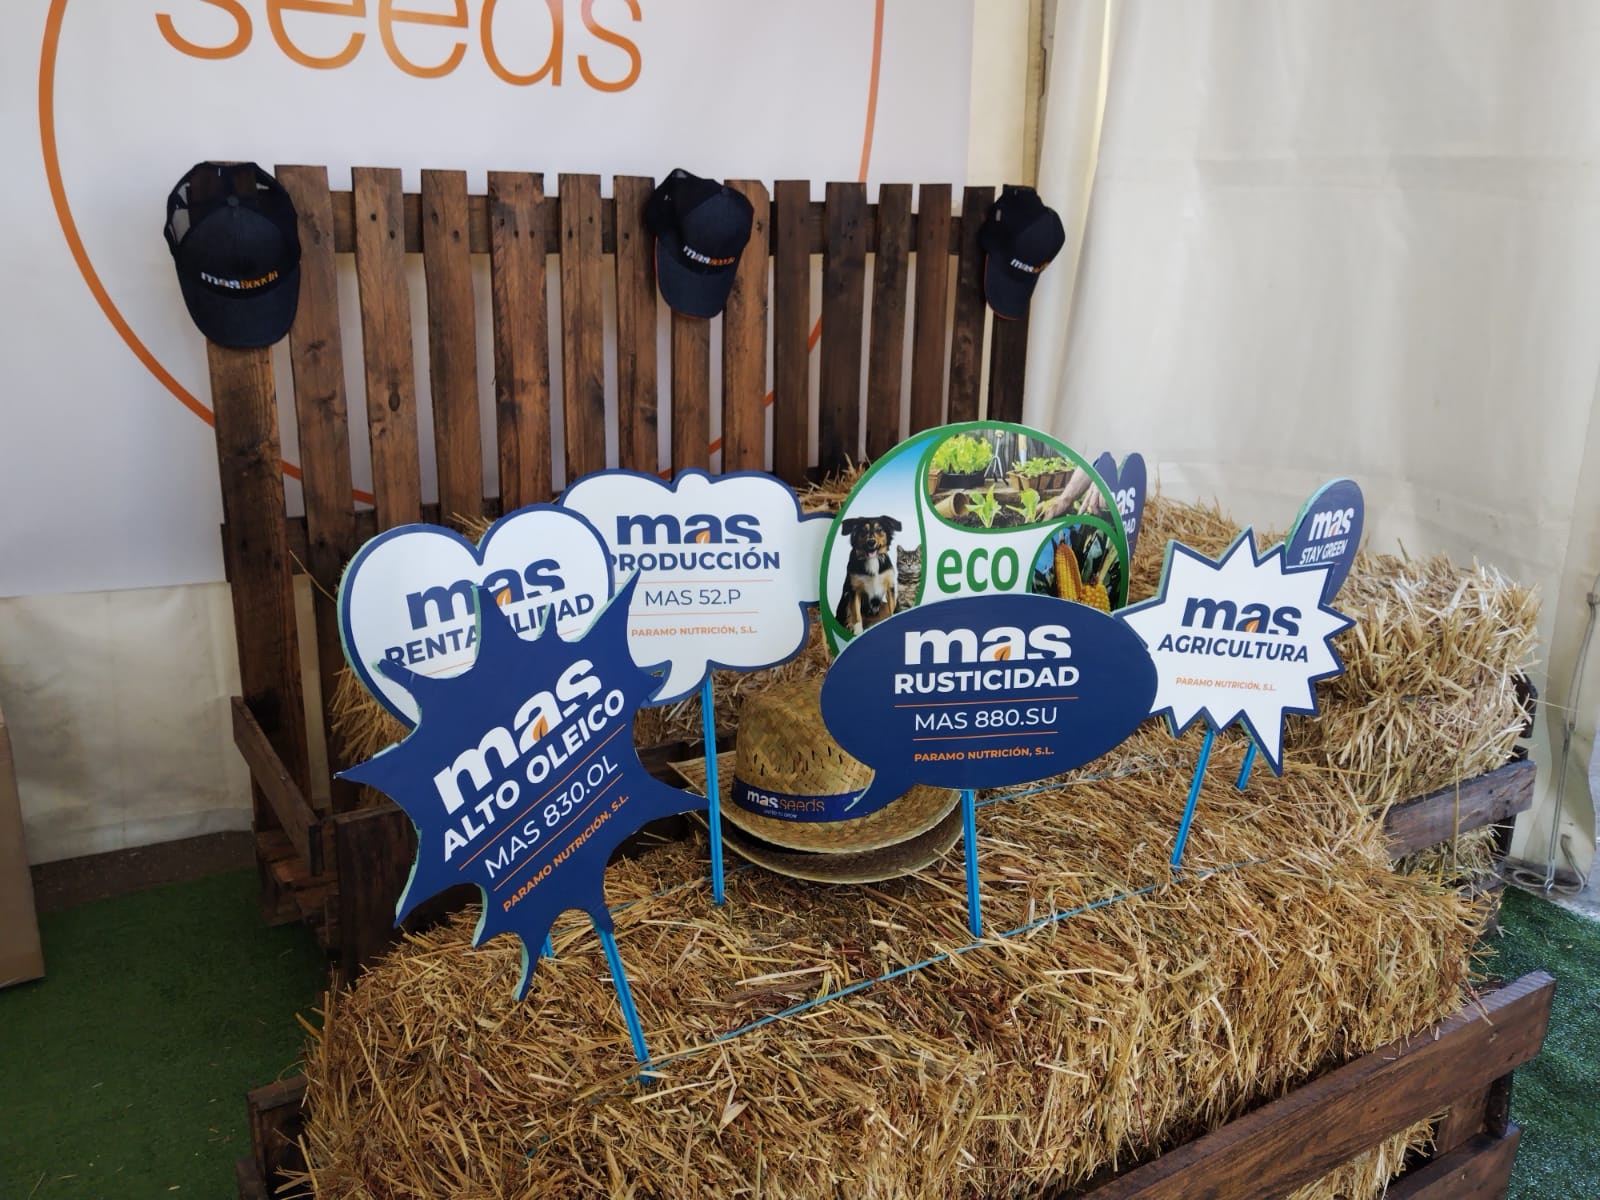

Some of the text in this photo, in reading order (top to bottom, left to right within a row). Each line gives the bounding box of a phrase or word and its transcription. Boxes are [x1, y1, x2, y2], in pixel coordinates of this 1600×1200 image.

[1111, 487, 1136, 516] as
[616, 514, 762, 545] mas
[1308, 508, 1354, 541] mas
[1299, 539, 1349, 565] STAY GREEN
[936, 547, 1019, 593] eco
[406, 558, 566, 630] mas
[645, 589, 741, 606] MAS 52.P
[631, 625, 758, 637] PARAMO NUTRICIÓN, S.L.
[1181, 597, 1302, 636] mas
[905, 624, 1072, 665] mas
[1157, 634, 1308, 663] AGRICULTURA
[895, 666, 1080, 694] RUSTICIDAD
[1175, 677, 1277, 691] PARAMO NUTRICIÓN, S.L.
[915, 707, 1058, 731] MAS 880.SU
[433, 659, 602, 815] mas
[914, 746, 1055, 762] PARAMO NUTRICIÓN, S.L.
[444, 689, 625, 862] ALTO OLEICO
[484, 754, 618, 879] MAS 830.OL
[502, 795, 630, 912] PARAMO NUTRICIÓN, S.L.
